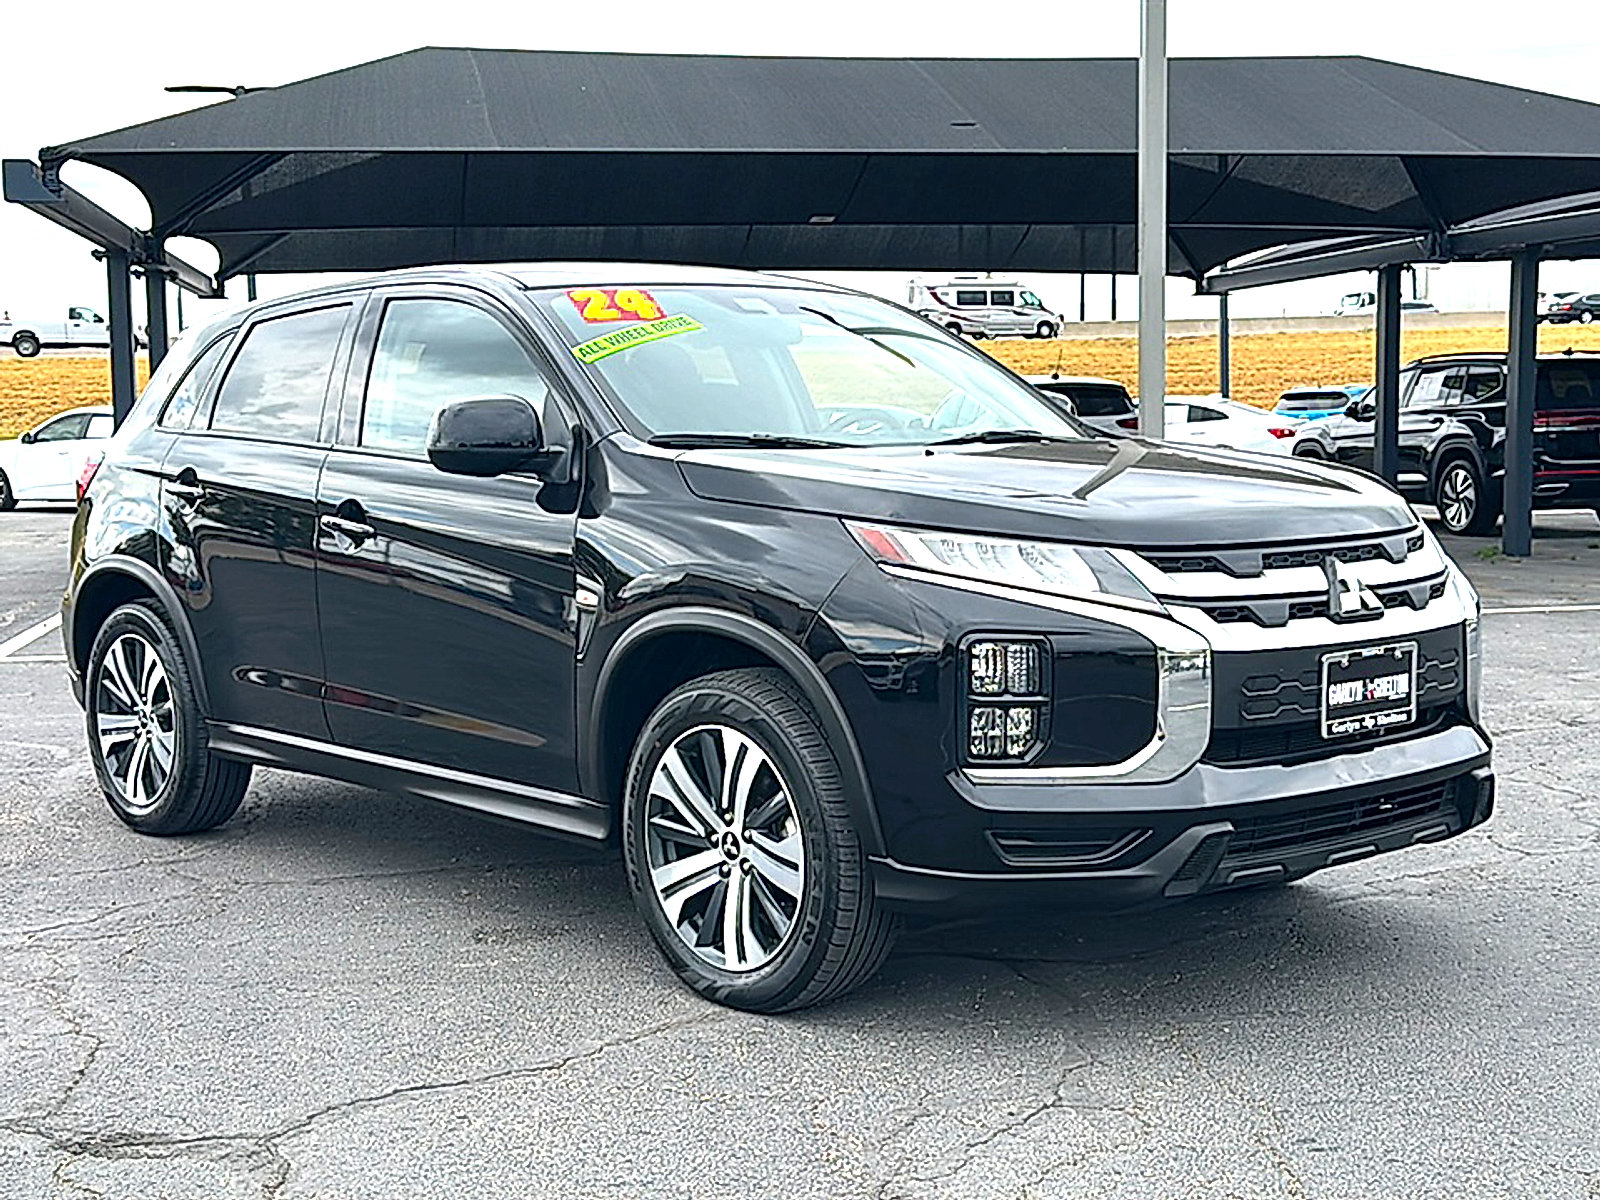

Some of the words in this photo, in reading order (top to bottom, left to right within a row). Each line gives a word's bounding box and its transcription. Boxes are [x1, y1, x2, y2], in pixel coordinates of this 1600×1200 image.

[569, 289, 661, 320] 24
[578, 341, 607, 358] ALL
[603, 325, 653, 348] WHEEL
[652, 315, 692, 334] DRIVE
